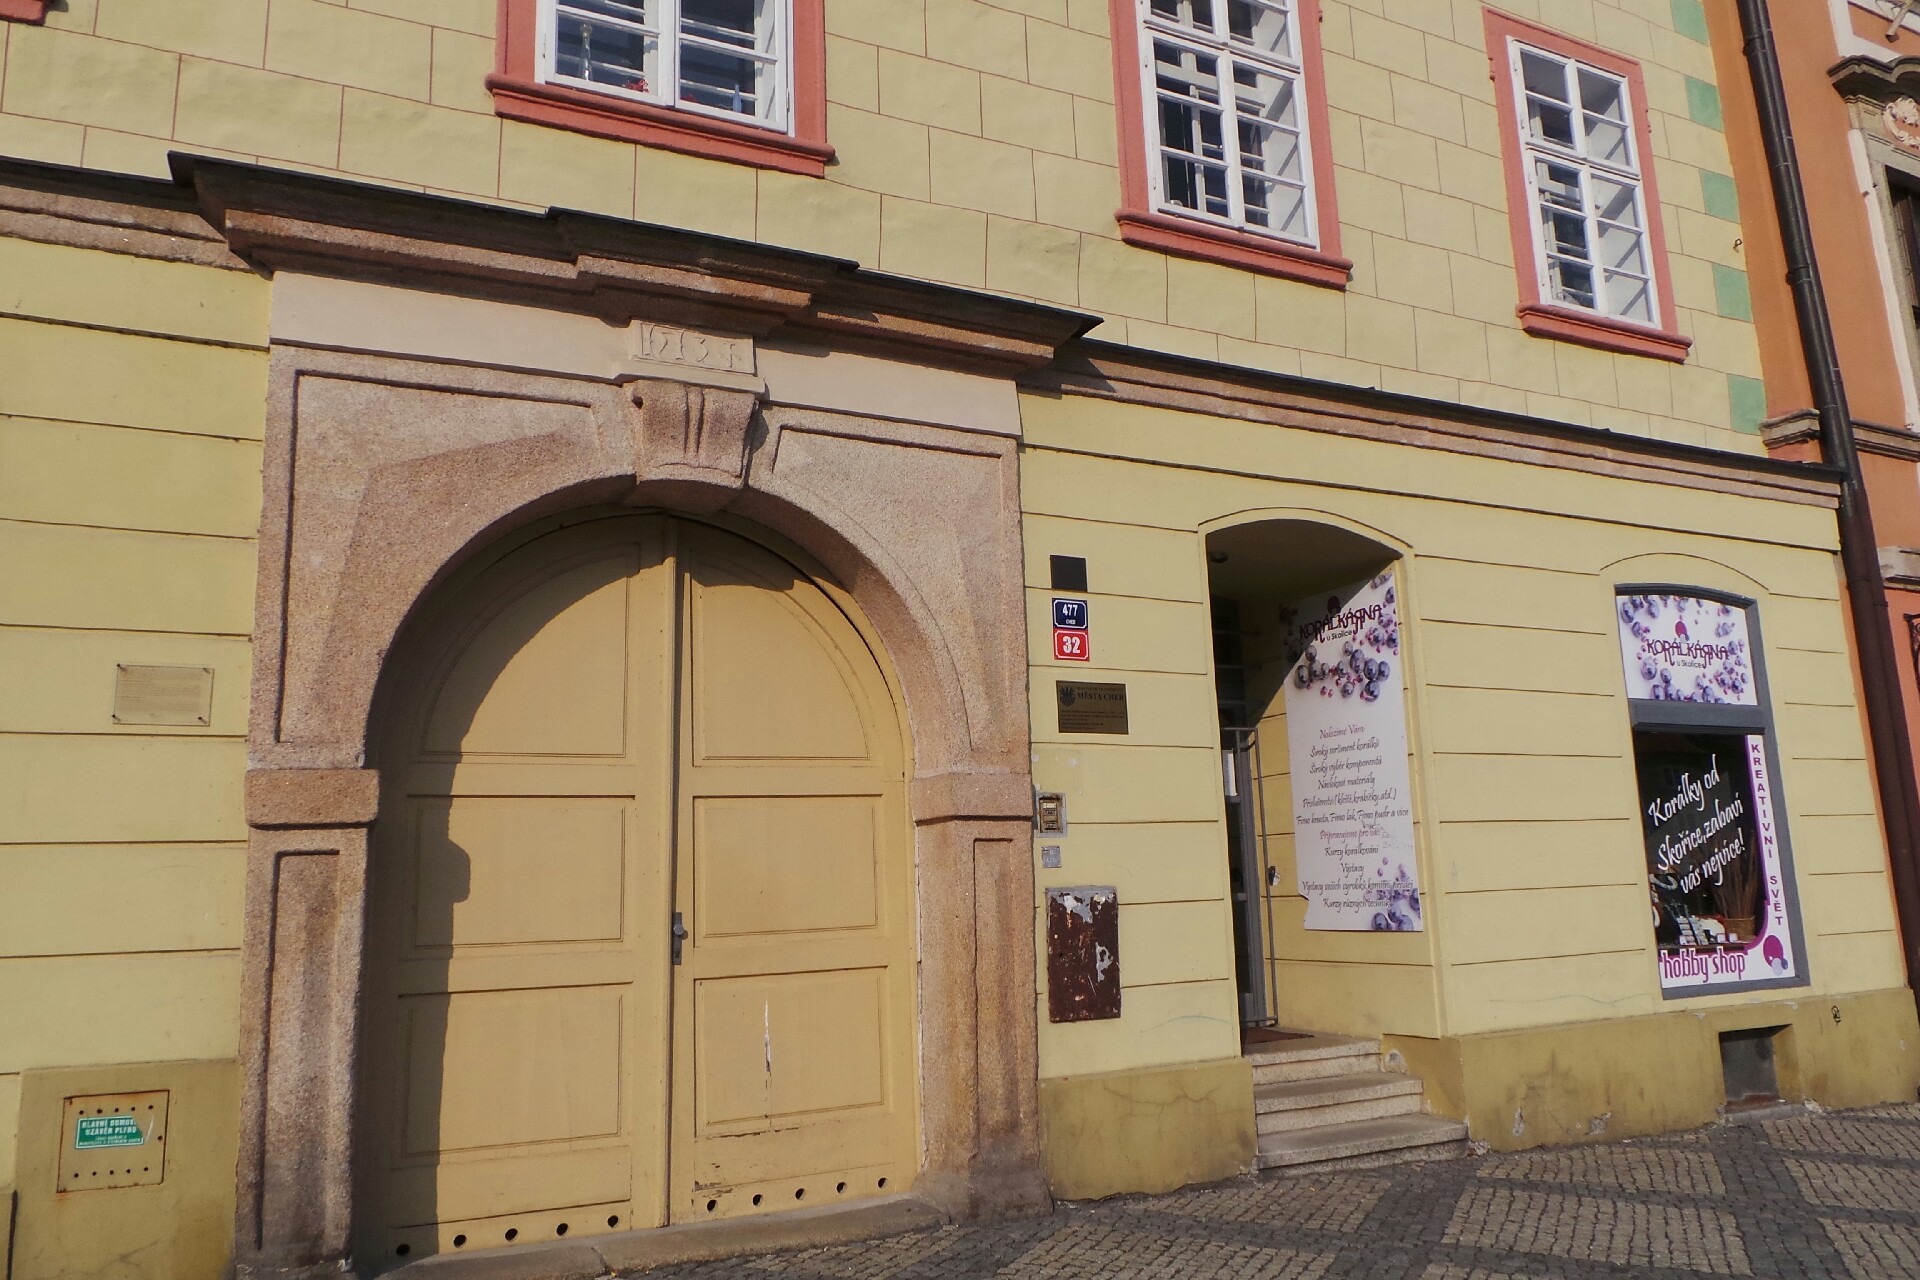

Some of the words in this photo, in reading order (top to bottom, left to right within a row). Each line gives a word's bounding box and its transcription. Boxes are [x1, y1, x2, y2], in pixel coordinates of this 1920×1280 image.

[1062, 603, 1078, 617] 477
[1062, 635, 1081, 654] 32
[1647, 772, 1706, 827] Korálky
[1704, 754, 1721, 791] od
[1750, 743, 1774, 859] KREATIVNÍ
[1679, 865, 1702, 895] vás
[1702, 827, 1746, 886] nejvíce!
[1769, 875, 1784, 926] SVĚT
[1662, 949, 1710, 983] hobby
[1712, 946, 1746, 980] shop
